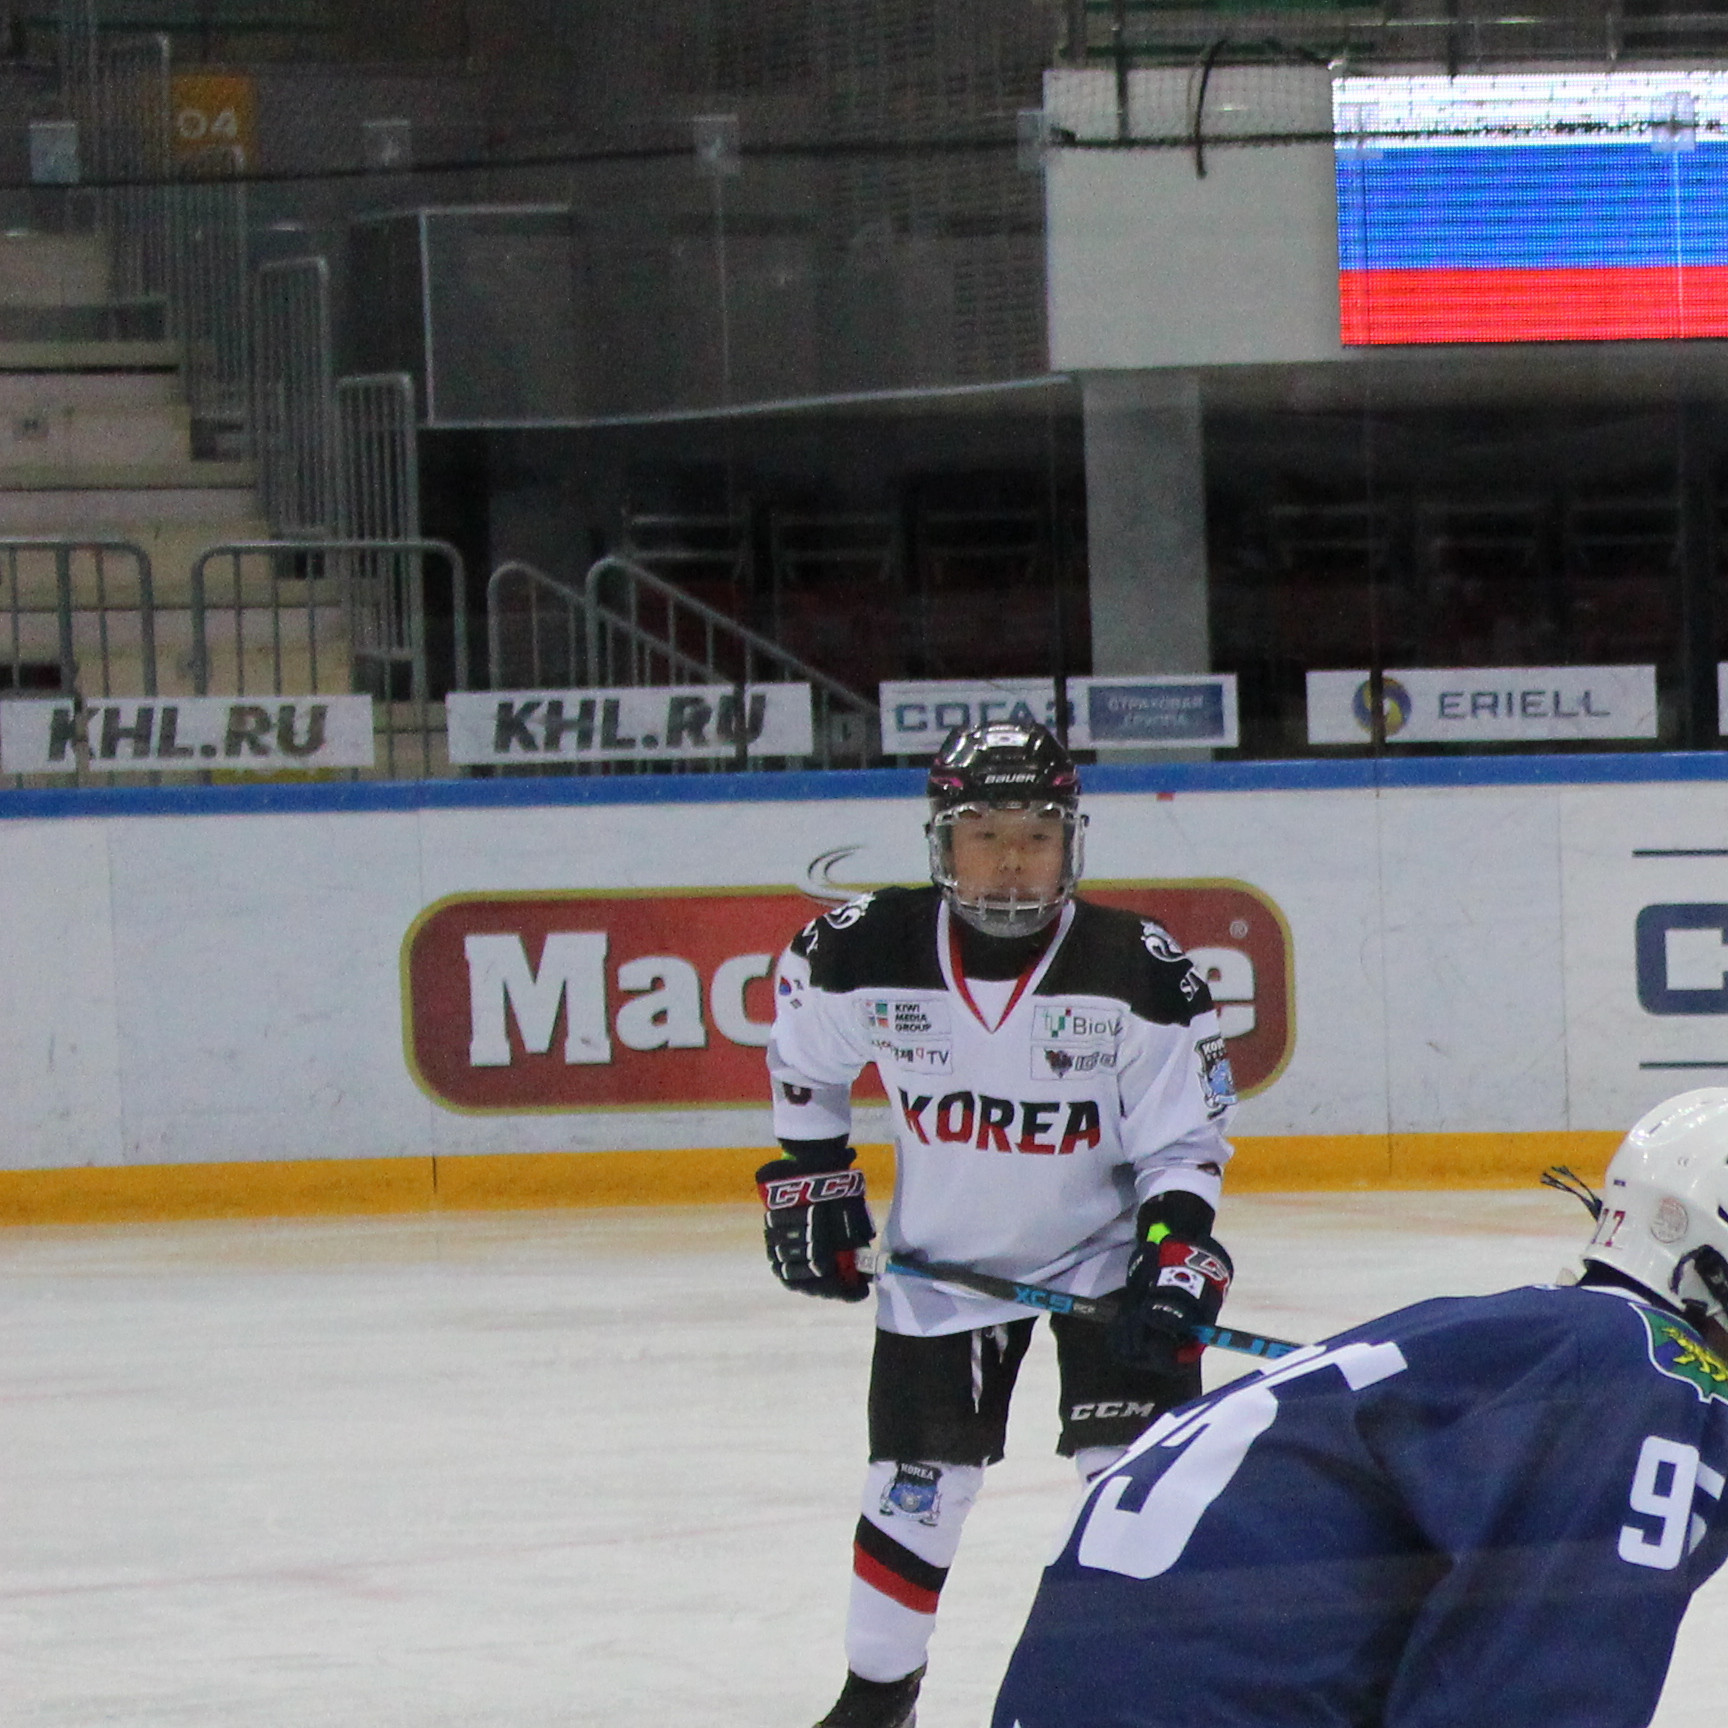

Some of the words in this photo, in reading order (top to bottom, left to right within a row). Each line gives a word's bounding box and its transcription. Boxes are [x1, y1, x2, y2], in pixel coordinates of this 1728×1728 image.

[1437, 689, 1612, 720] ERIELL
[46, 704, 329, 761] KHL.RU
[493, 693, 767, 753] KHL.RU
[984, 773, 1037, 785] BAUER
[895, 1003, 920, 1013] KIWI
[895, 1013, 928, 1023] MEDIA
[895, 1023, 932, 1033] GROUP
[926, 1049, 949, 1066] TV
[899, 1090, 1101, 1155] KOREA
[765, 1169, 866, 1210] CC
[1070, 1401, 1156, 1422] CCM
[901, 1462, 935, 1481] KOREA
